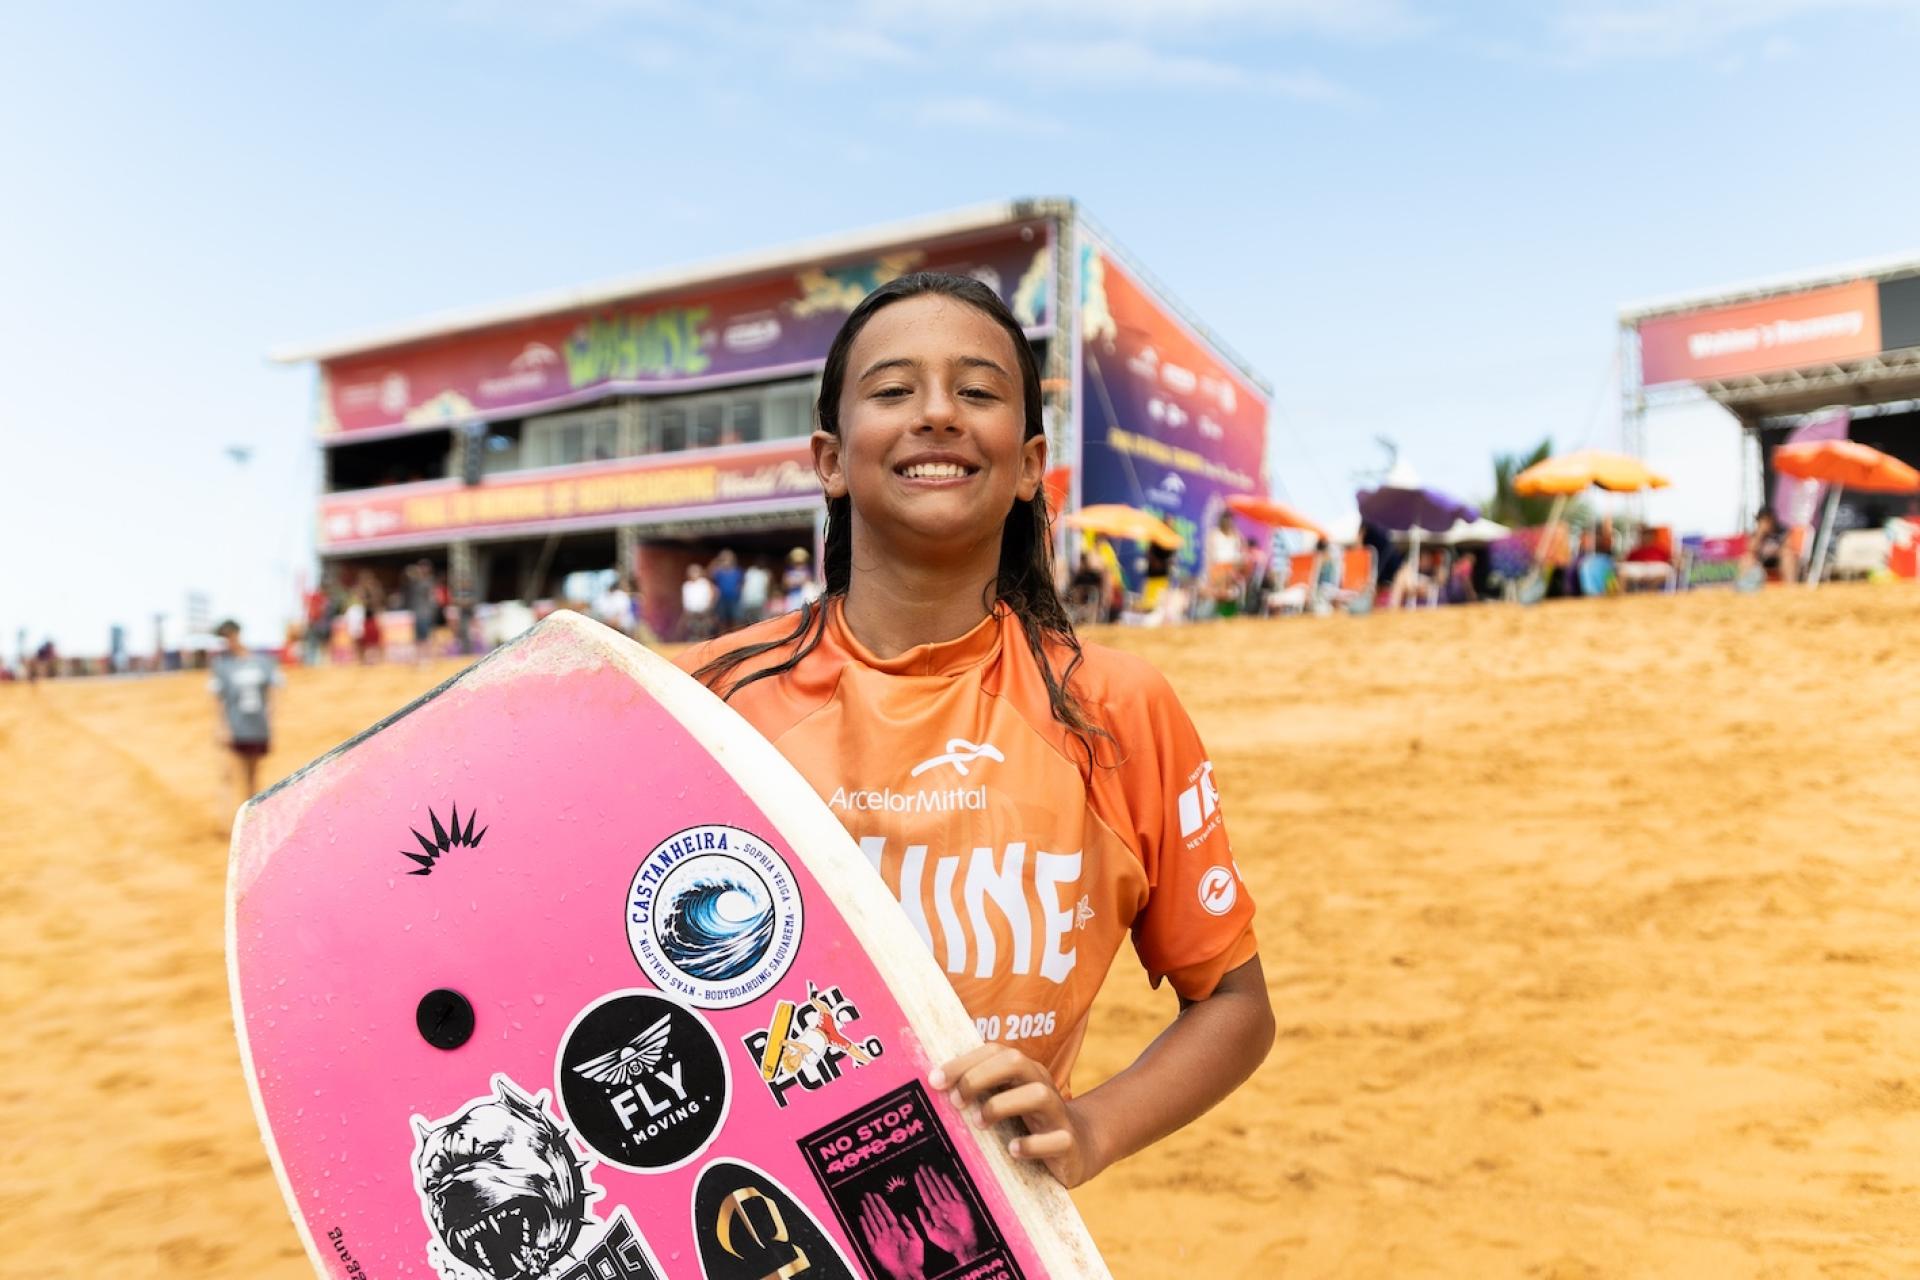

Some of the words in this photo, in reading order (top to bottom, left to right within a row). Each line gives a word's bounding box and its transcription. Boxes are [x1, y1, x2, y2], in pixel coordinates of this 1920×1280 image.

[828, 784, 987, 813] ArcelorMittal
[632, 832, 728, 924] CASTANHEIRA
[743, 843, 775, 872] SOPHIA
[772, 871, 791, 904] VEIGA
[704, 968, 773, 1001] BODYBOARDING
[768, 912, 795, 972] SAQUAREMA
[669, 977, 697, 997] NYAS
[1005, 1010, 1056, 1041] 2026
[610, 1061, 688, 1131] FLY
[632, 1100, 700, 1146] MOVING
[819, 1135, 853, 1160] NO
[856, 1103, 914, 1141] STOP
